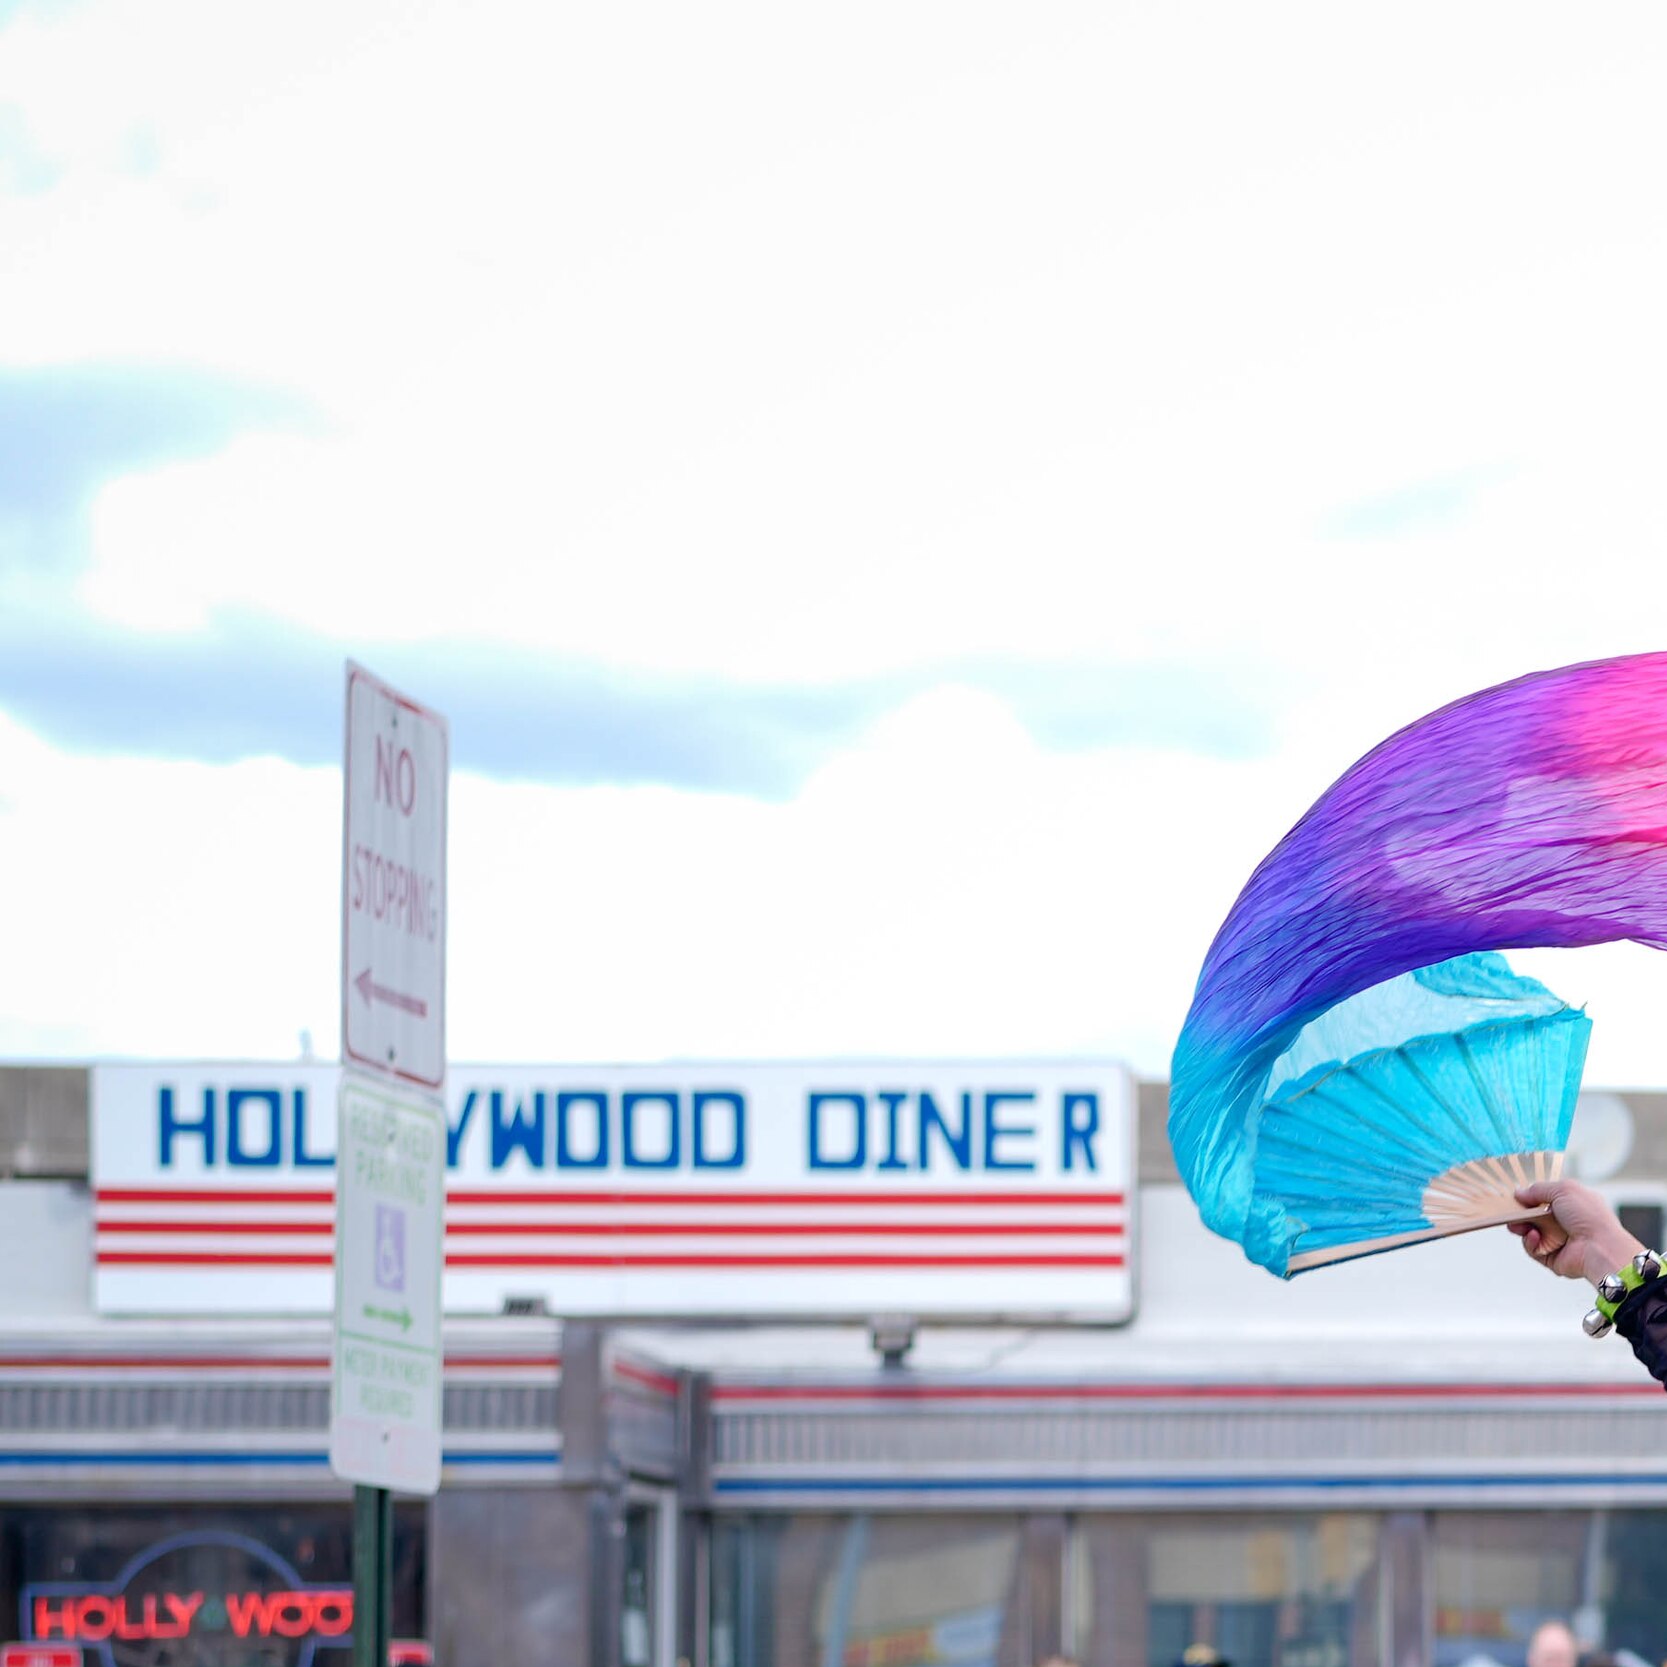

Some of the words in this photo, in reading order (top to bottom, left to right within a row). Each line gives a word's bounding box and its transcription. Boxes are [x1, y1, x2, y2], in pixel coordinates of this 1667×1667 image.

[375, 734, 415, 818] NO
[353, 844, 436, 942] STOPPING
[160, 1088, 745, 1169] HOLYWOOD
[808, 1092, 1100, 1172] DINER
[34, 1590, 204, 1641] HOLLY
